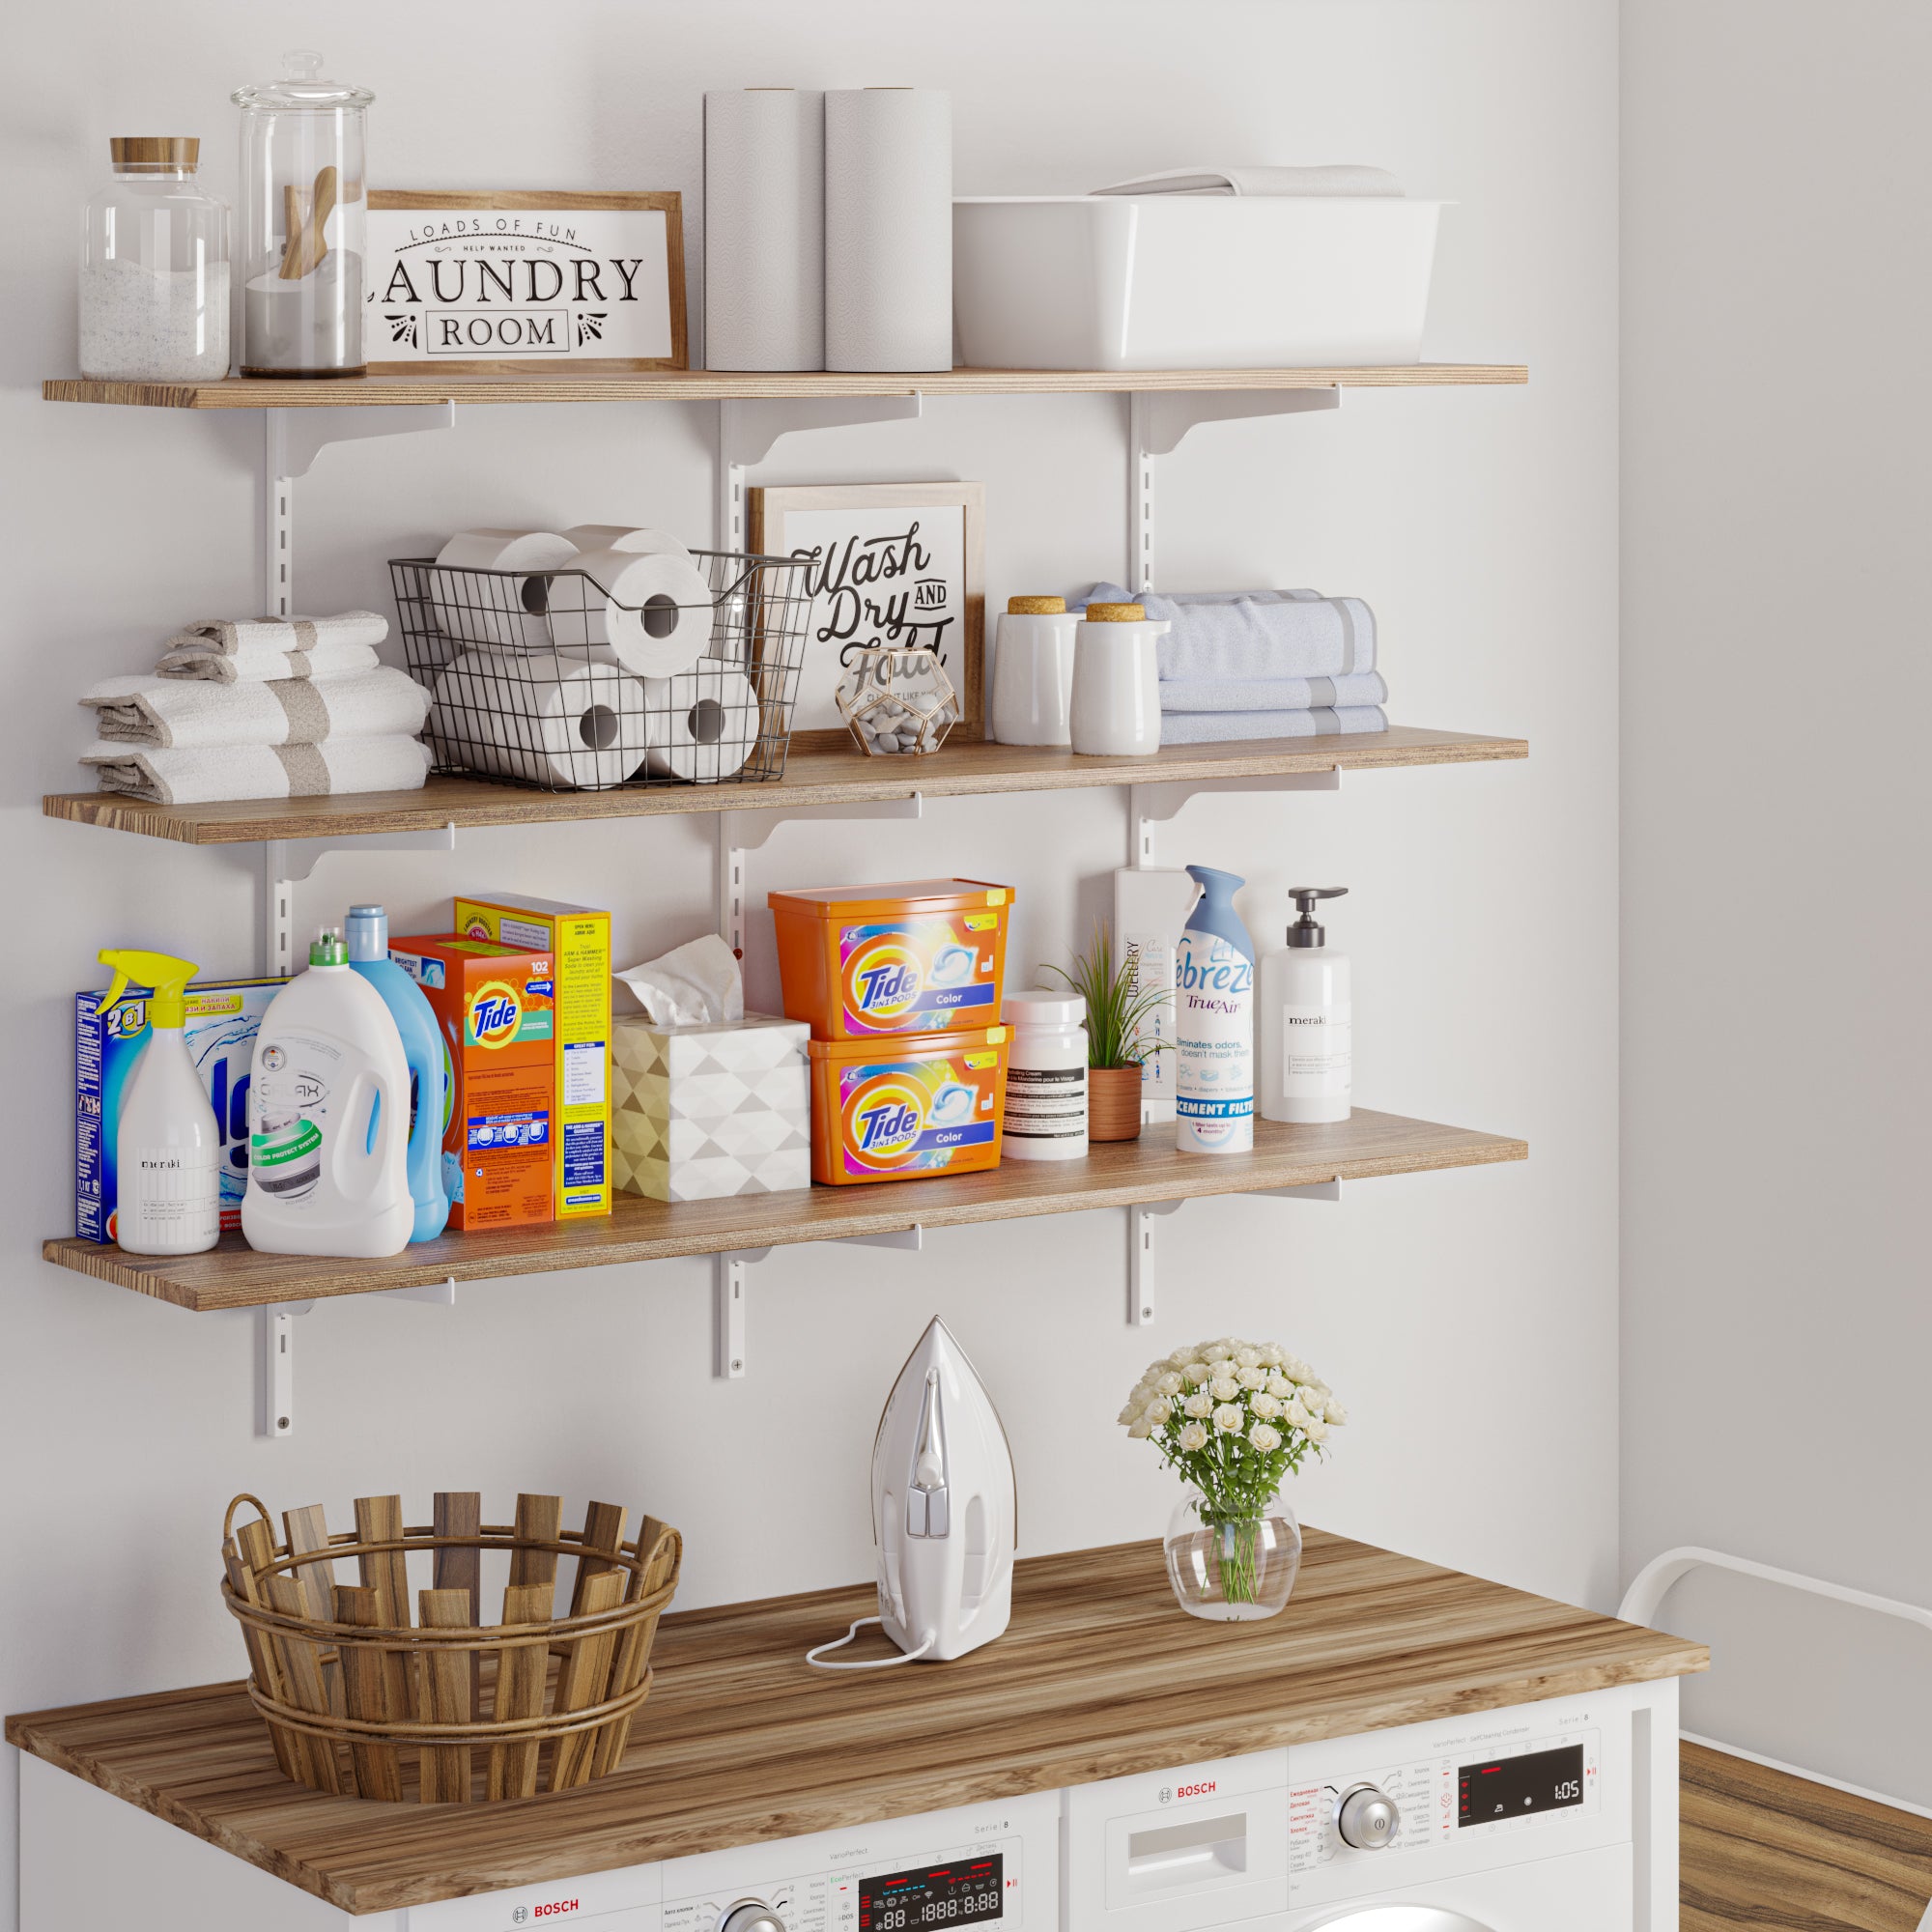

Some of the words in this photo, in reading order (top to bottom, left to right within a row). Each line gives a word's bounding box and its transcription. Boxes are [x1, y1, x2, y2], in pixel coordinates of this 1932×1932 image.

[411, 219, 480, 241] LOADS
[496, 218, 522, 231] OF
[537, 222, 577, 241] FUN
[367, 259, 643, 303] AUNDRY
[440, 318, 555, 346] ROOM
[791, 521, 931, 598] Wash
[915, 584, 947, 605] AND
[817, 585, 929, 643] Dry
[530, 960, 549, 973] 102
[860, 965, 918, 1009] Tide
[891, 991, 918, 1005] PODS
[936, 994, 962, 1005] Color
[473, 998, 518, 1040] Tide
[1289, 1015, 1326, 1025] meraki
[1209, 1050, 1233, 1059] mask
[1177, 1100, 1226, 1116] CEMENT
[860, 1104, 918, 1150] Tide
[891, 1130, 917, 1143] PODS
[271, 1147, 298, 1159] PROTECT
[298, 1133, 320, 1150] SYSTEM
[936, 1131, 962, 1144] Color
[1178, 1781, 1216, 1798] BOSCH
[1554, 1780, 1579, 1800] 1:05
[975, 1823, 998, 1834] Serie
[829, 1847, 868, 1861] VarioPerfect
[830, 1871, 865, 1884] EcoPerfect
[534, 1898, 579, 1918] BOSCH
[922, 1899, 957, 1922] 1888
[964, 1891, 999, 1915] 8:88
[884, 1909, 905, 1930] 88
